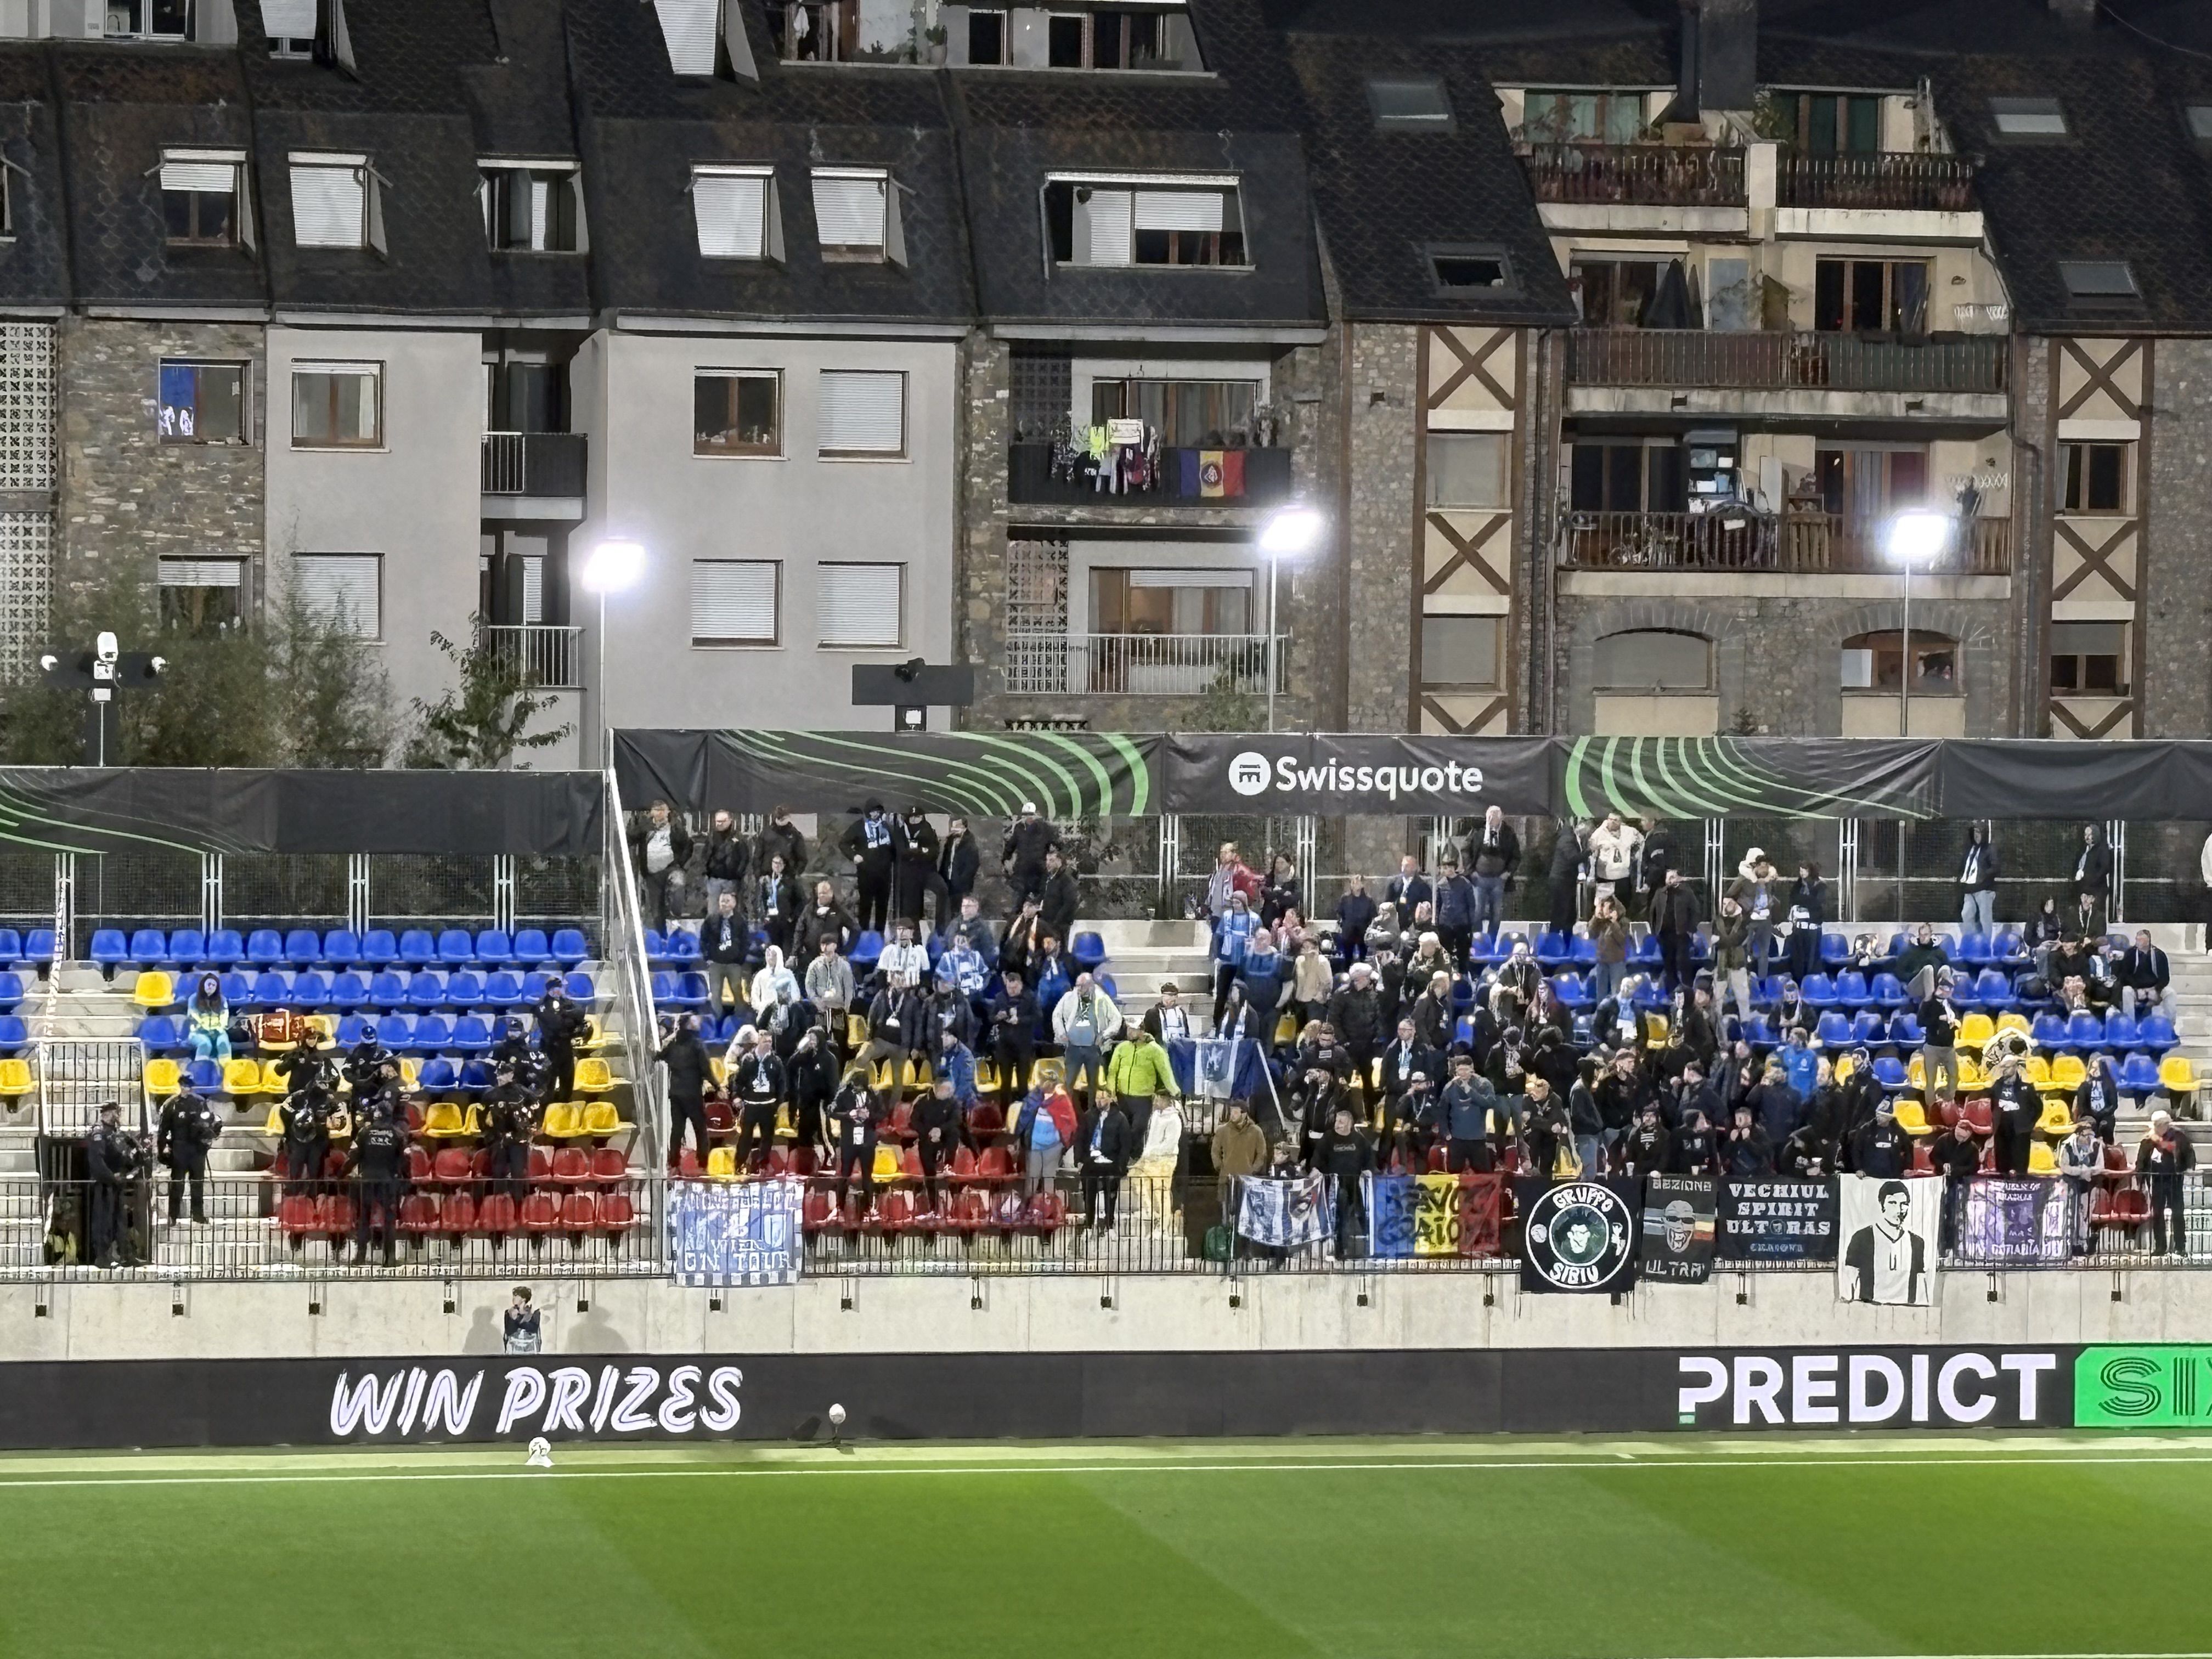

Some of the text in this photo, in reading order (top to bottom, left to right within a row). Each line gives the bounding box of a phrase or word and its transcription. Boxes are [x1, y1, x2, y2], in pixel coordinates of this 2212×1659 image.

[1276, 756, 1483, 801] Swissquote
[1552, 1187, 1613, 1212] GRUPPO
[1729, 1183, 1829, 1199] VECHIUL
[1737, 1202, 1819, 1217] SPIRIT
[1549, 1262, 1599, 1284] SIBIU
[330, 1364, 743, 1436] WIN PRIZES
[1678, 1353, 2212, 1424] PREDICT SI
